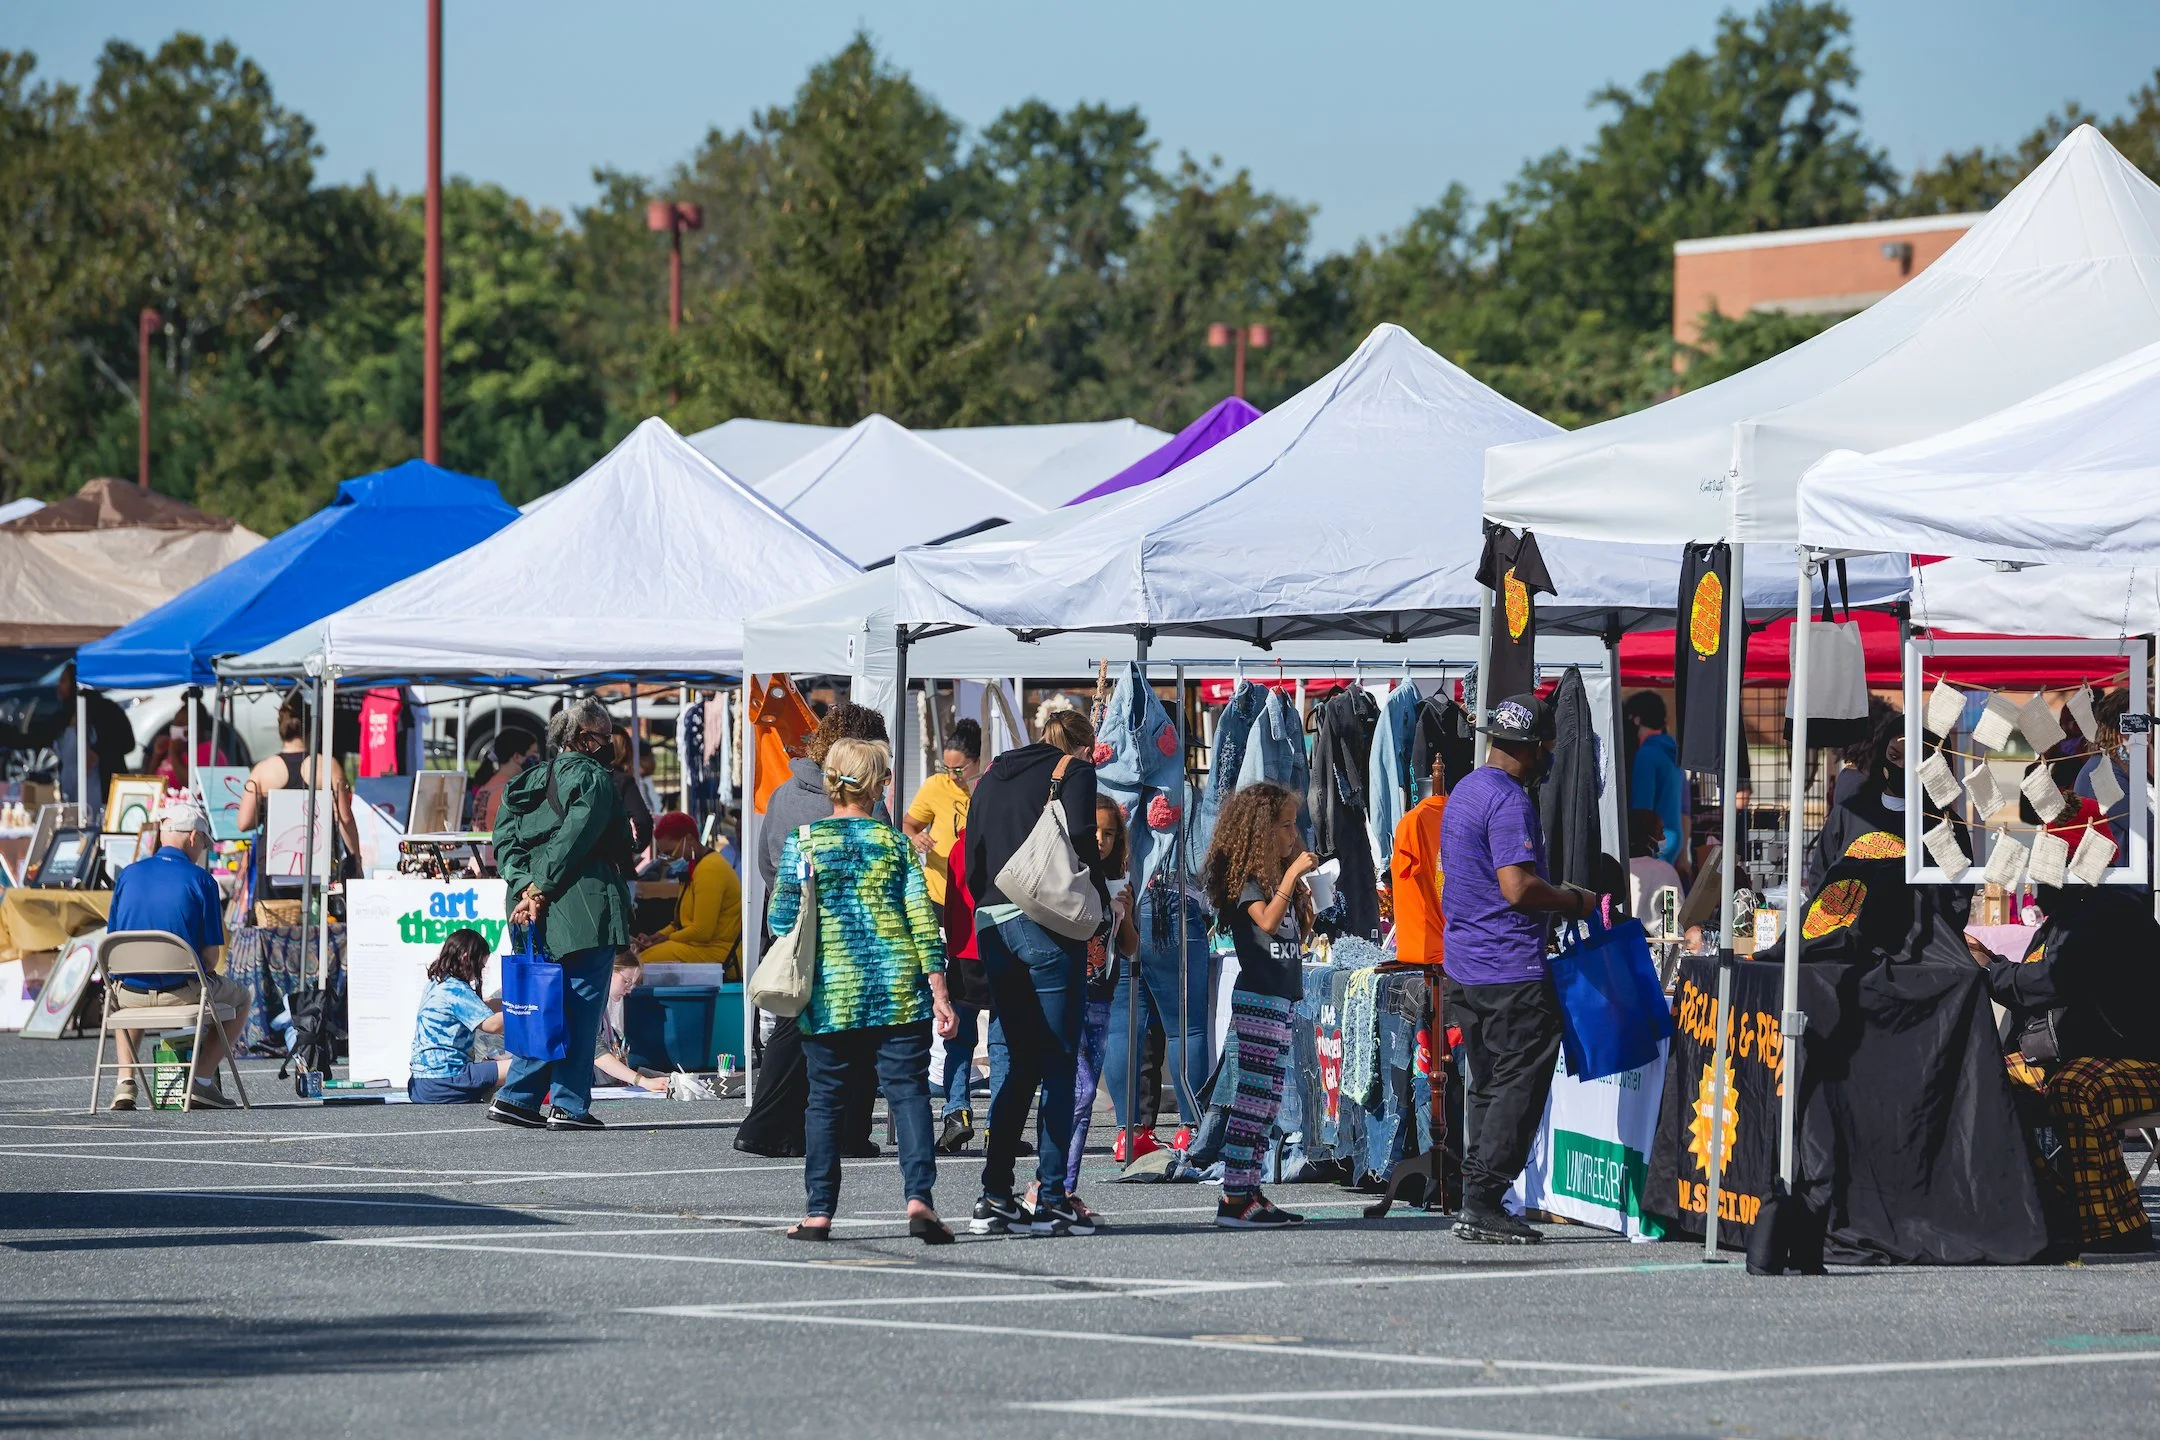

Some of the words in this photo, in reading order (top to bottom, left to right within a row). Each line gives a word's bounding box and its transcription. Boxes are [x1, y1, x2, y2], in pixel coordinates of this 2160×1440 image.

[430, 888, 478, 919] art
[397, 909, 507, 953] thery
[1678, 980, 1735, 1058] RECLAM
[1739, 1012, 1755, 1058] &
